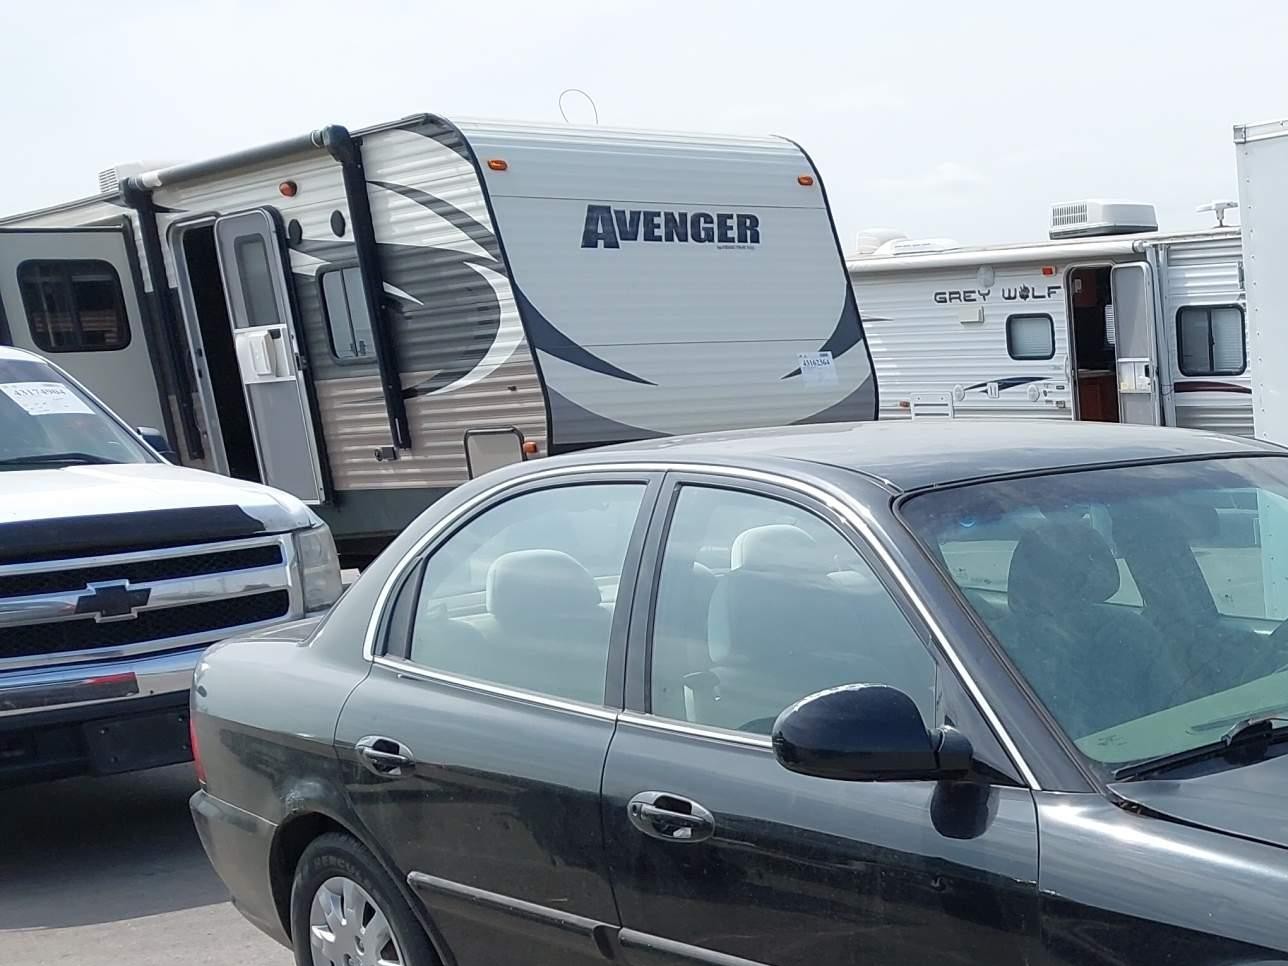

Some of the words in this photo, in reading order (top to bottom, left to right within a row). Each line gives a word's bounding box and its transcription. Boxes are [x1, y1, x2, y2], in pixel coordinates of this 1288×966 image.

[581, 204, 761, 249] AVENGER
[934, 289, 991, 304] GREY
[1001, 284, 1062, 301] WOLF
